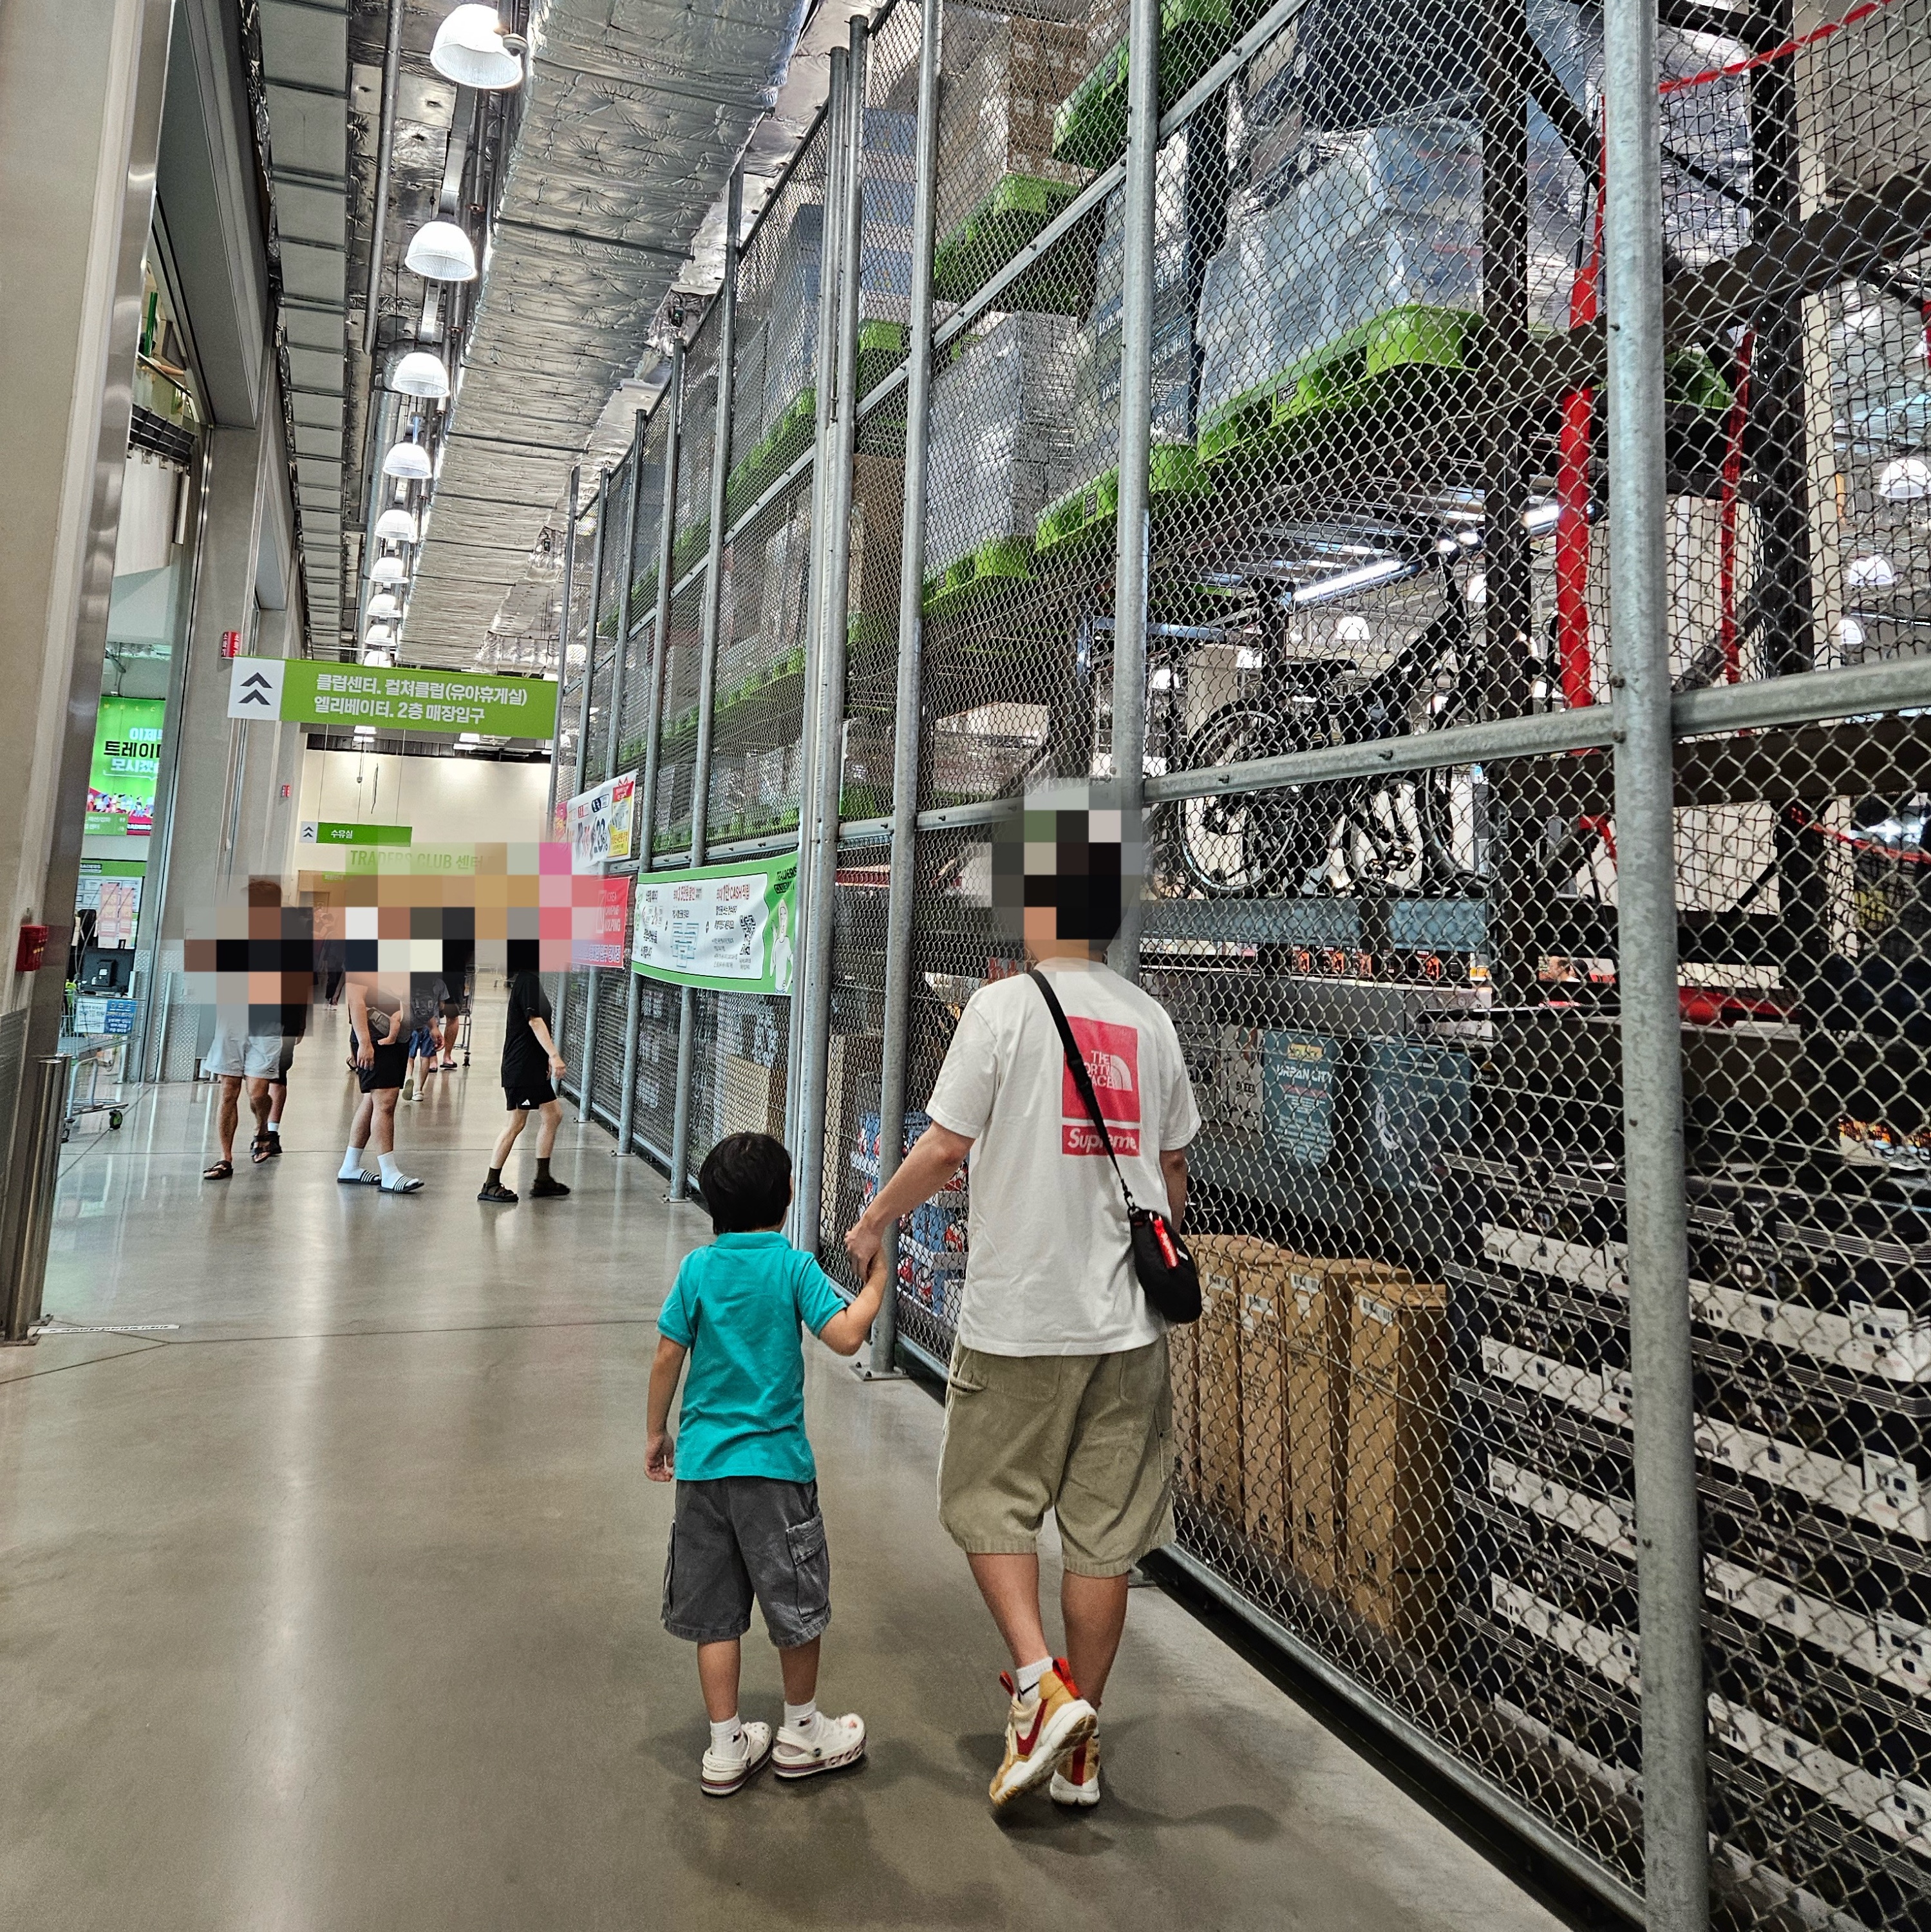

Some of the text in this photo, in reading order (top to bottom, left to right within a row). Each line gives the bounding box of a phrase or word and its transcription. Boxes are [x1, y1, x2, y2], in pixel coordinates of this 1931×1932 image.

[385, 678, 528, 706] 컬쳐클럽(유아휴게실)
[397, 701, 424, 720] 2층
[426, 706, 485, 724] 매장입구
[330, 829, 353, 839] 수유실
[350, 850, 412, 867] TRADERS
[418, 853, 453, 869] CLUB
[1091, 1050, 1110, 1065] THE
[1084, 1062, 1111, 1076] ORTH
[1277, 1065, 1310, 1079] URBAN
[1091, 1074, 1115, 1089] ACE
[1236, 1081, 1256, 1094] SEED
[1068, 1128, 1137, 1153] Suprme
